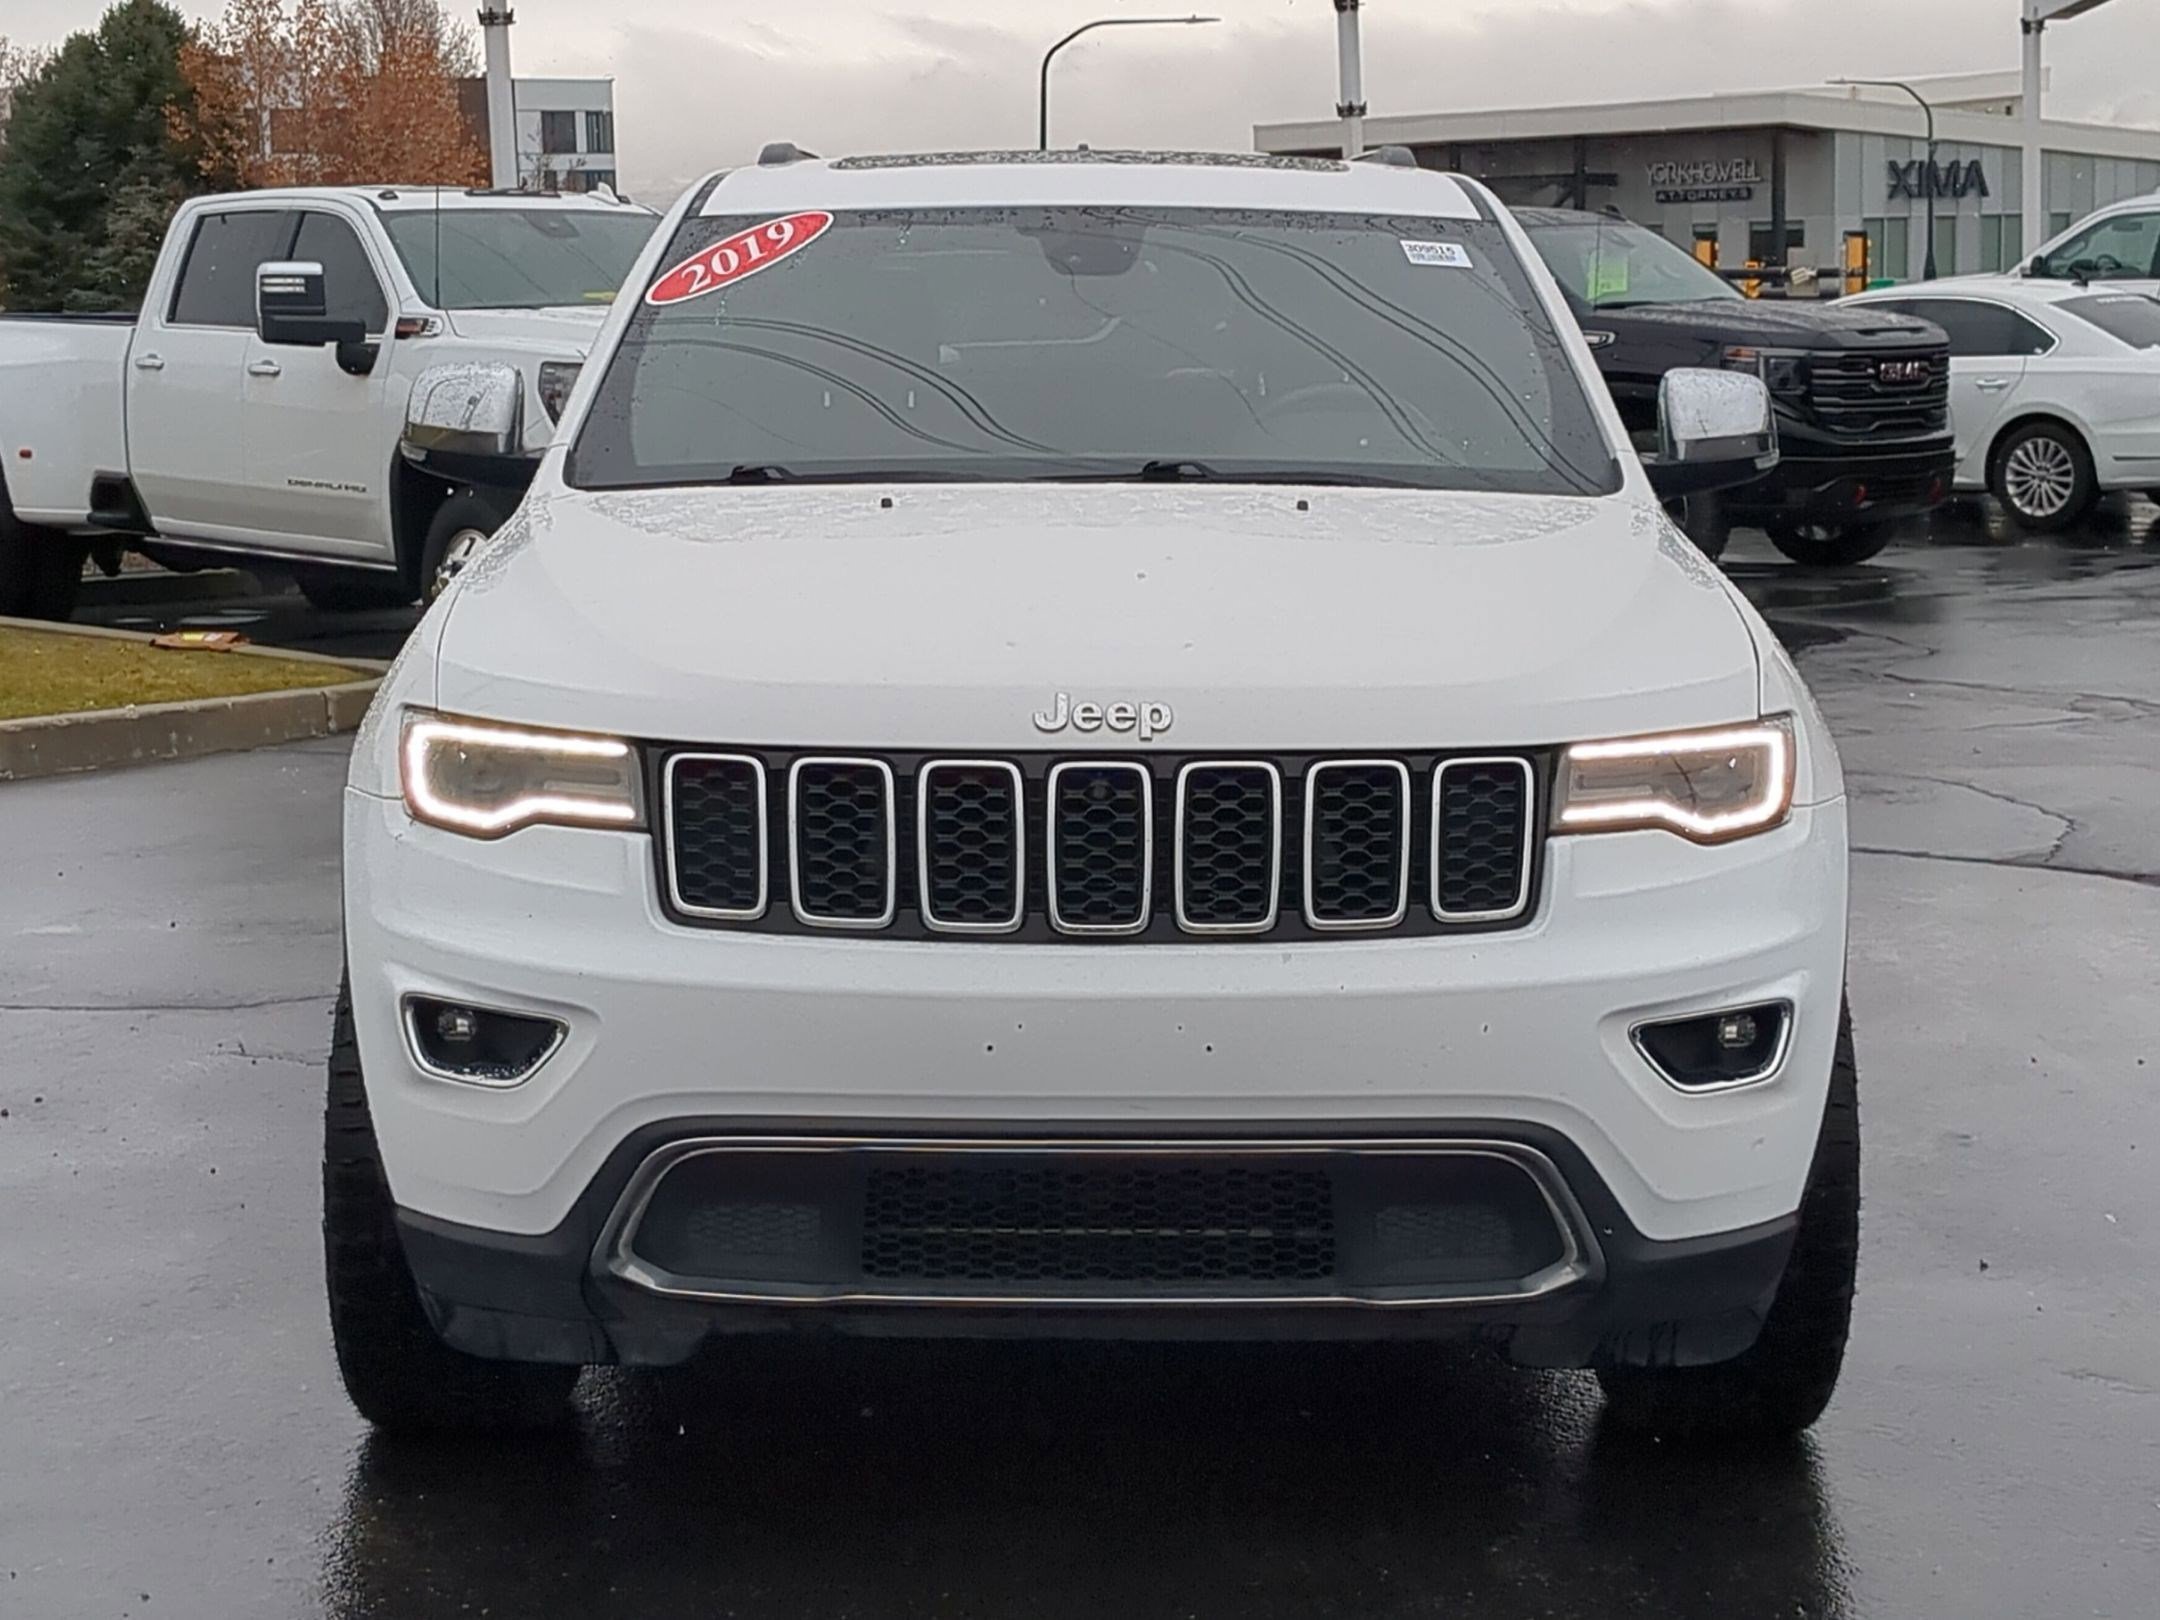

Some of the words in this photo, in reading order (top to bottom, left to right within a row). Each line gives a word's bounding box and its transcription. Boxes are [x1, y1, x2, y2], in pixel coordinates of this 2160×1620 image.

[1887, 159, 1990, 199] XIMA
[681, 221, 795, 294] 2019
[1033, 691, 1174, 742] Jeep
